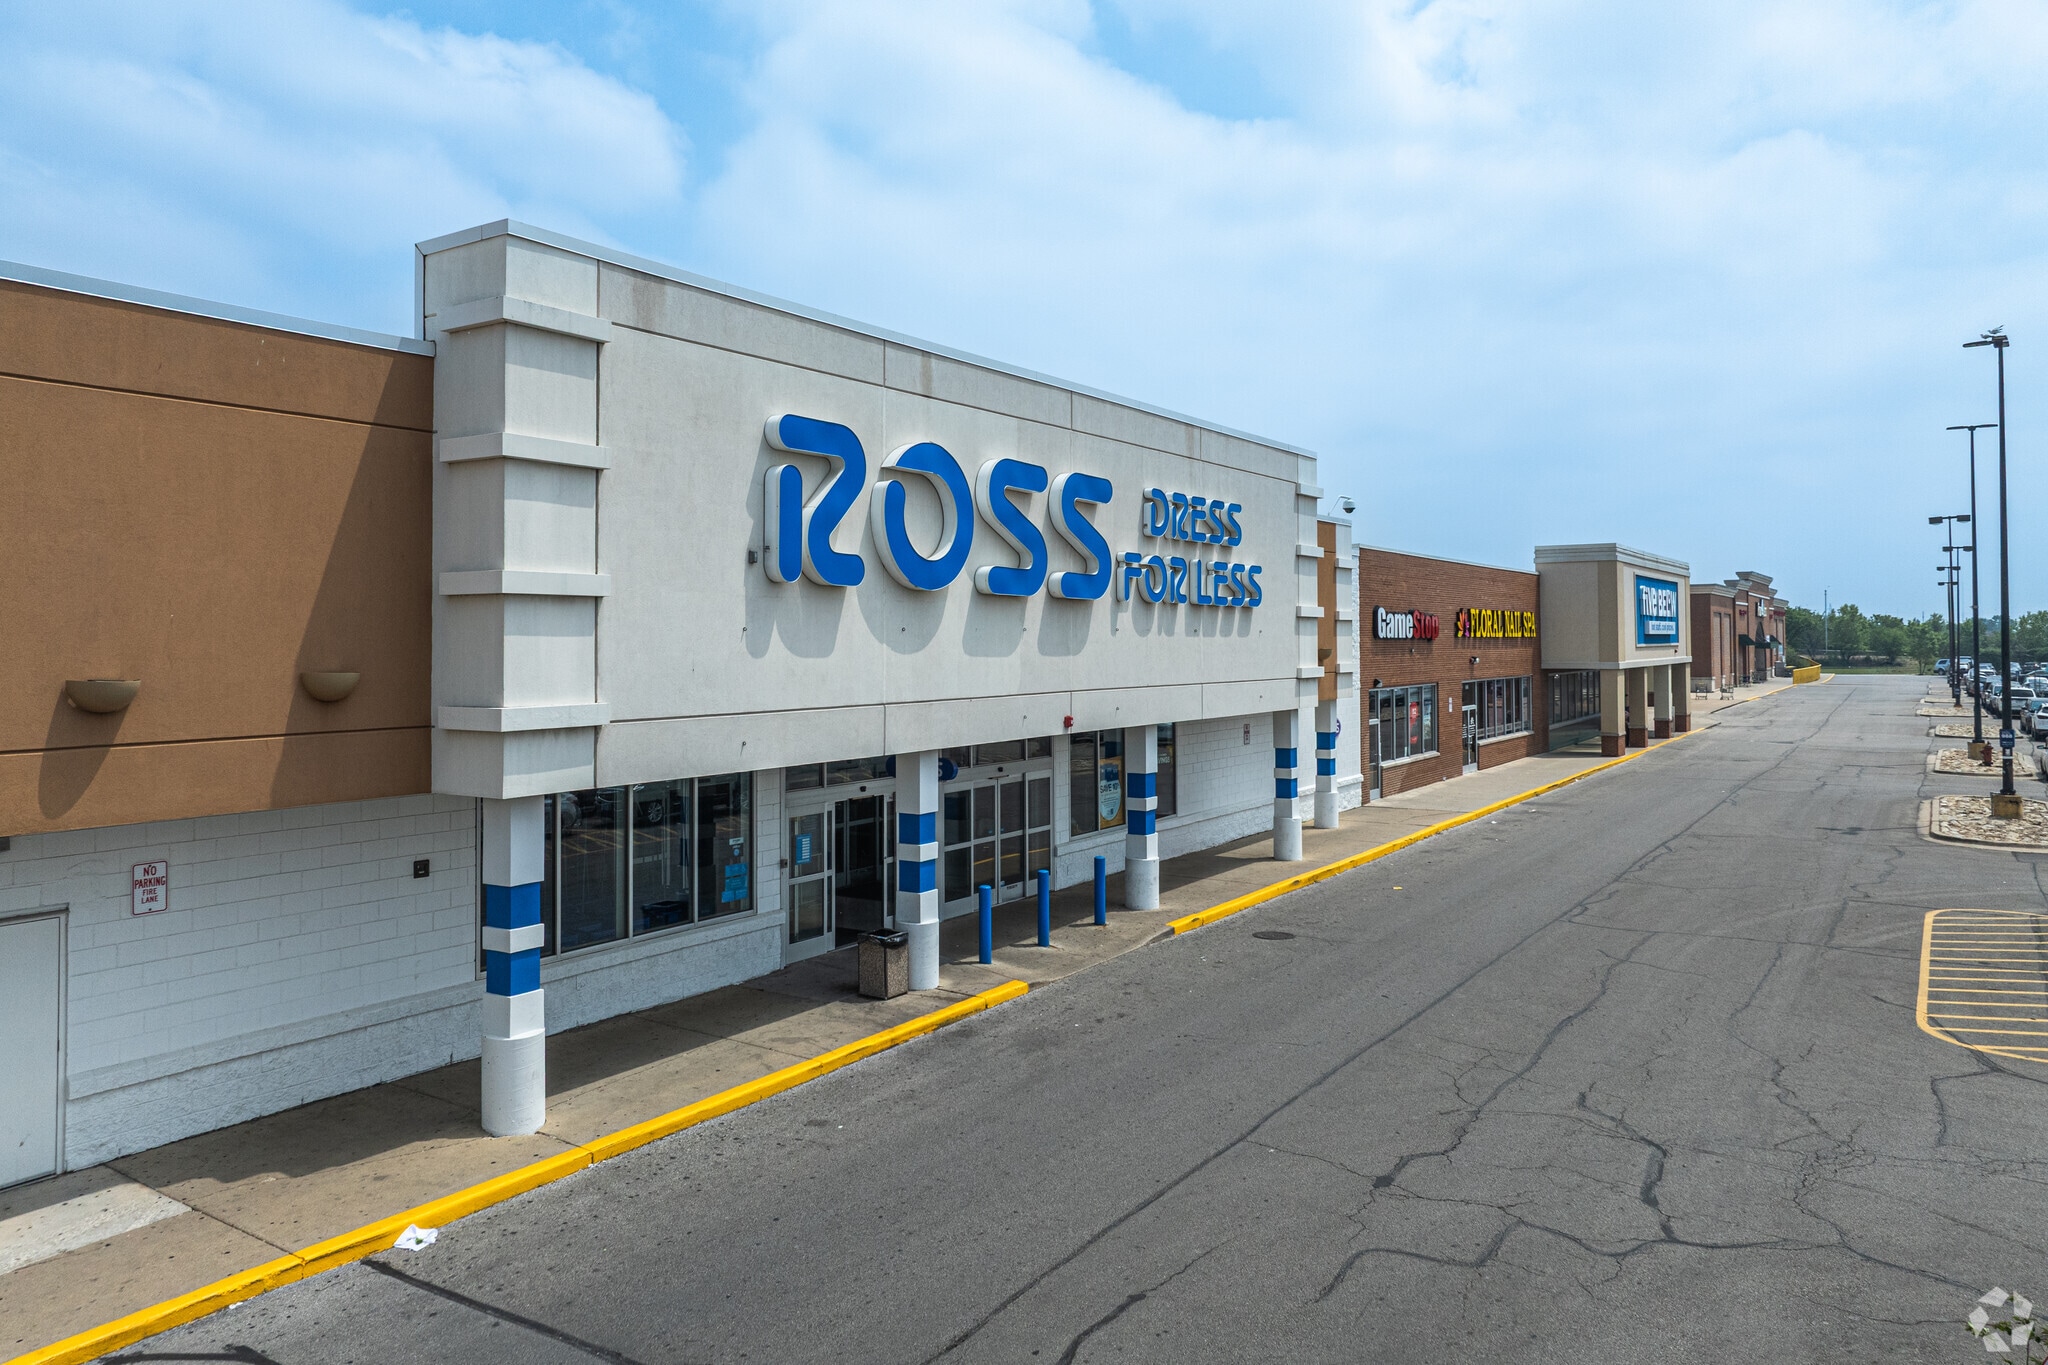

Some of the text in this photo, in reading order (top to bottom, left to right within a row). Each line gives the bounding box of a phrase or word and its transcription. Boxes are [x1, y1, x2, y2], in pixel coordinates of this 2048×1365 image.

[764, 413, 1114, 601] ROSS
[1143, 487, 1243, 547] DRESS
[1116, 551, 1263, 608] FOR LESS
[1377, 606, 1440, 640] GameStop
[1470, 608, 1537, 638] FLORAL NAIL SPA
[134, 876, 166, 889] PARKING
[143, 865, 157, 877] NO
[141, 895, 159, 904] LANE
[143, 887, 158, 896] FIRE
